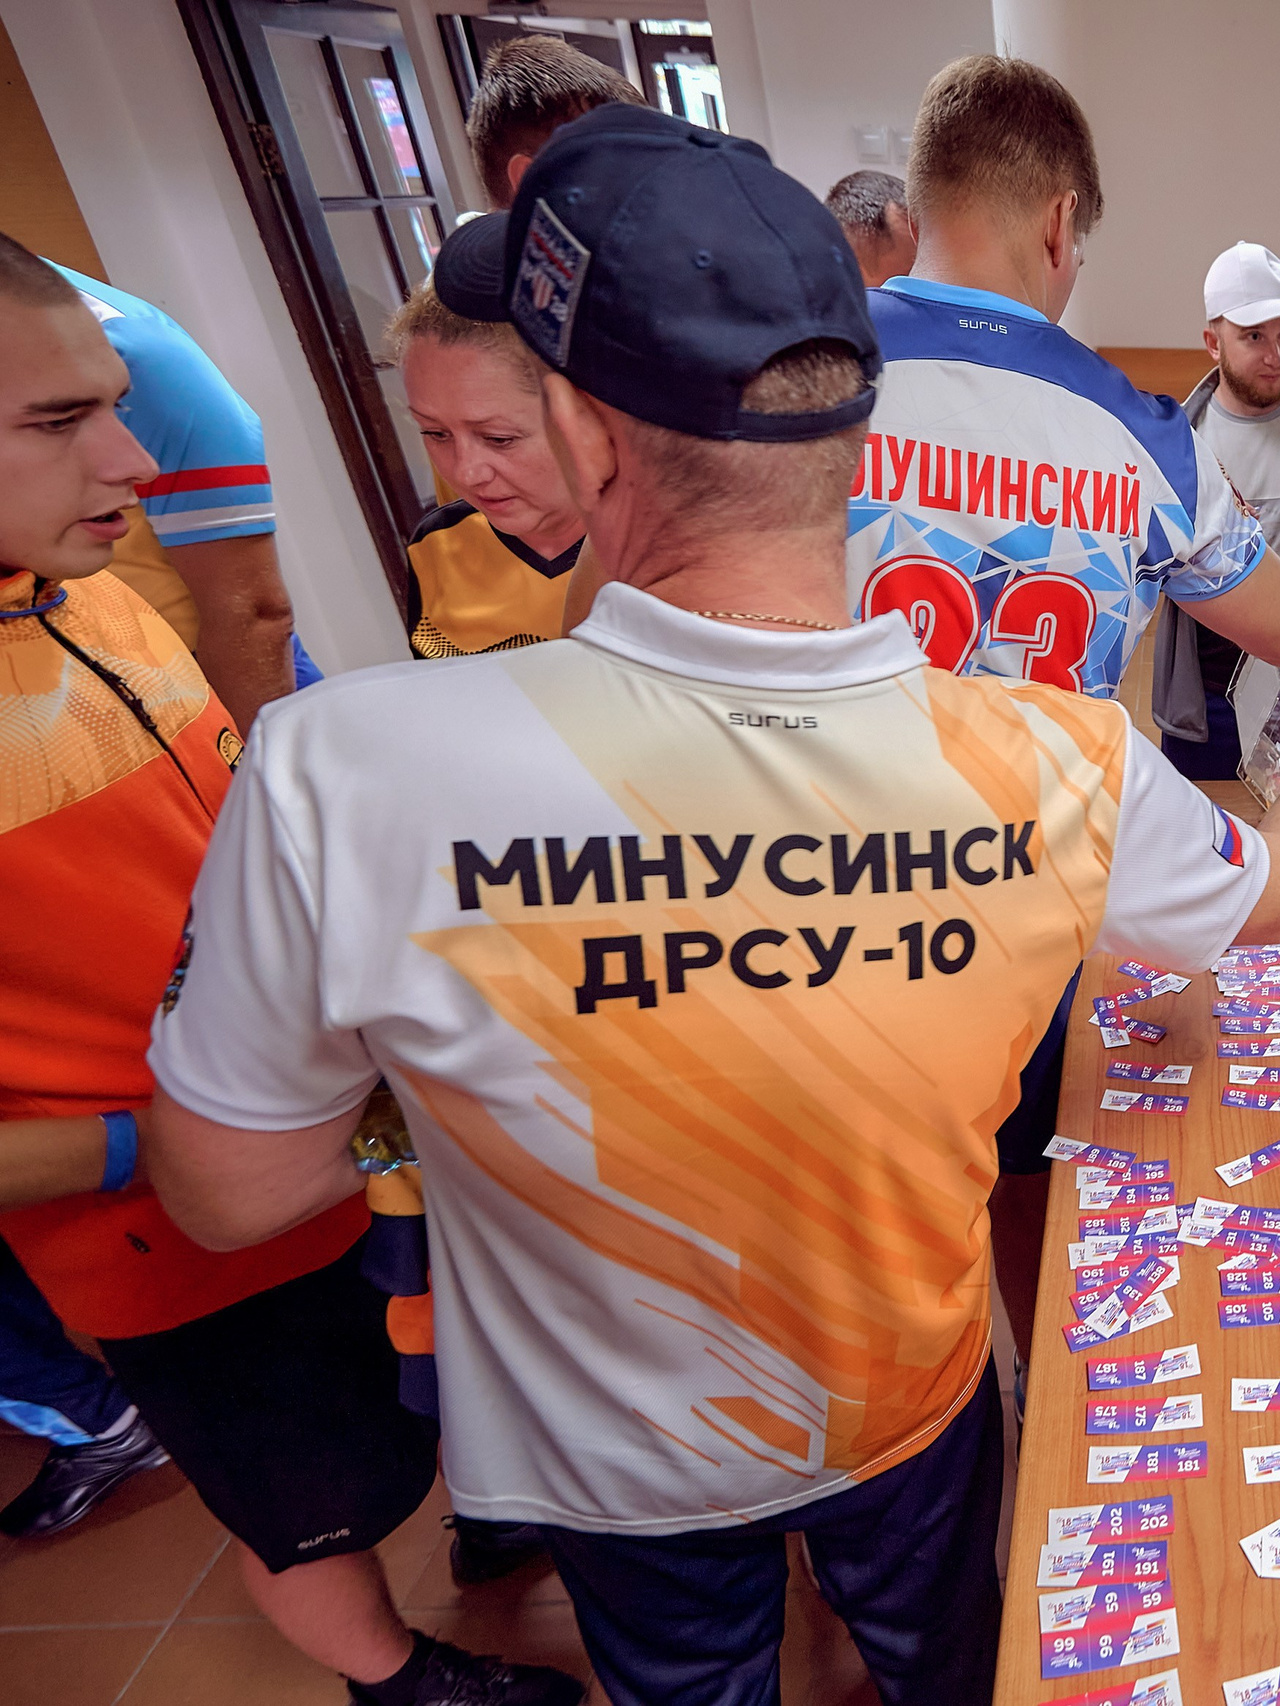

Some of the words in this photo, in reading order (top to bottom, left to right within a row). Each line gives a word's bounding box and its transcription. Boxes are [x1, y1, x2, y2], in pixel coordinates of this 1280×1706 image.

[959, 318, 1007, 335] surus
[729, 711, 818, 730] surus
[452, 820, 1037, 911] МИНУСИНСК
[575, 918, 977, 1015] ДРСУ-10
[1257, 1155, 1271, 1166] 98
[1145, 1171, 1165, 1179] 195
[1085, 1219, 1106, 1227] 182
[1239, 1210, 1250, 1226] 132
[1133, 1239, 1143, 1255] 174
[1225, 1232, 1237, 1247] 131
[1250, 1243, 1267, 1252] 131
[1158, 1244, 1178, 1253] 174
[1082, 1268, 1105, 1278] 190
[1147, 1265, 1166, 1284] 138
[1227, 1272, 1247, 1280] 128
[1262, 1272, 1273, 1290] 128
[1078, 1291, 1100, 1304] 192
[1122, 1285, 1143, 1301] 138
[1225, 1304, 1247, 1314] 105
[1262, 1302, 1274, 1321] 105
[1095, 1363, 1118, 1373] 187
[1134, 1360, 1146, 1380] 187
[1095, 1406, 1118, 1416] 175
[1135, 1406, 1146, 1426] 175
[1147, 1451, 1159, 1474] 181
[1177, 1460, 1200, 1472] 181
[1110, 1507, 1123, 1536] 202
[1140, 1515, 1168, 1530] 202
[1102, 1551, 1116, 1576] 191
[1134, 1562, 1159, 1576] 191
[1105, 1592, 1119, 1613] 59
[1142, 1592, 1162, 1608] 59
